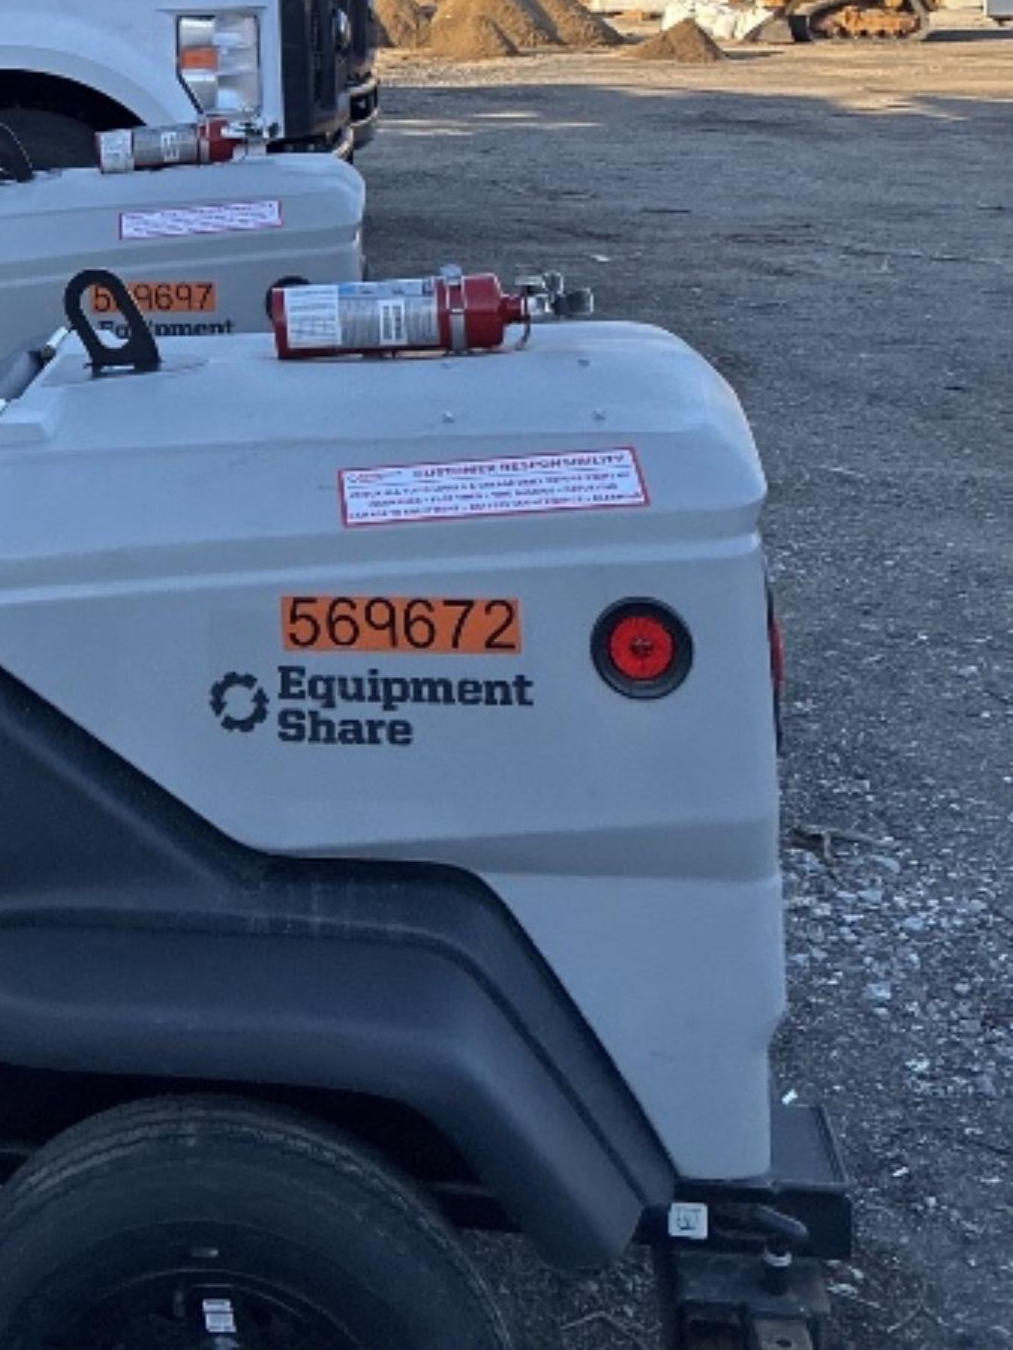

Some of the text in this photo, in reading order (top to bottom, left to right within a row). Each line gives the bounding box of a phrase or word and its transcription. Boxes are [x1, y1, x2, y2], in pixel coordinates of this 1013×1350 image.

[289, 597, 516, 649] 569672
[278, 666, 534, 711] Equipment
[278, 708, 413, 745] Share
